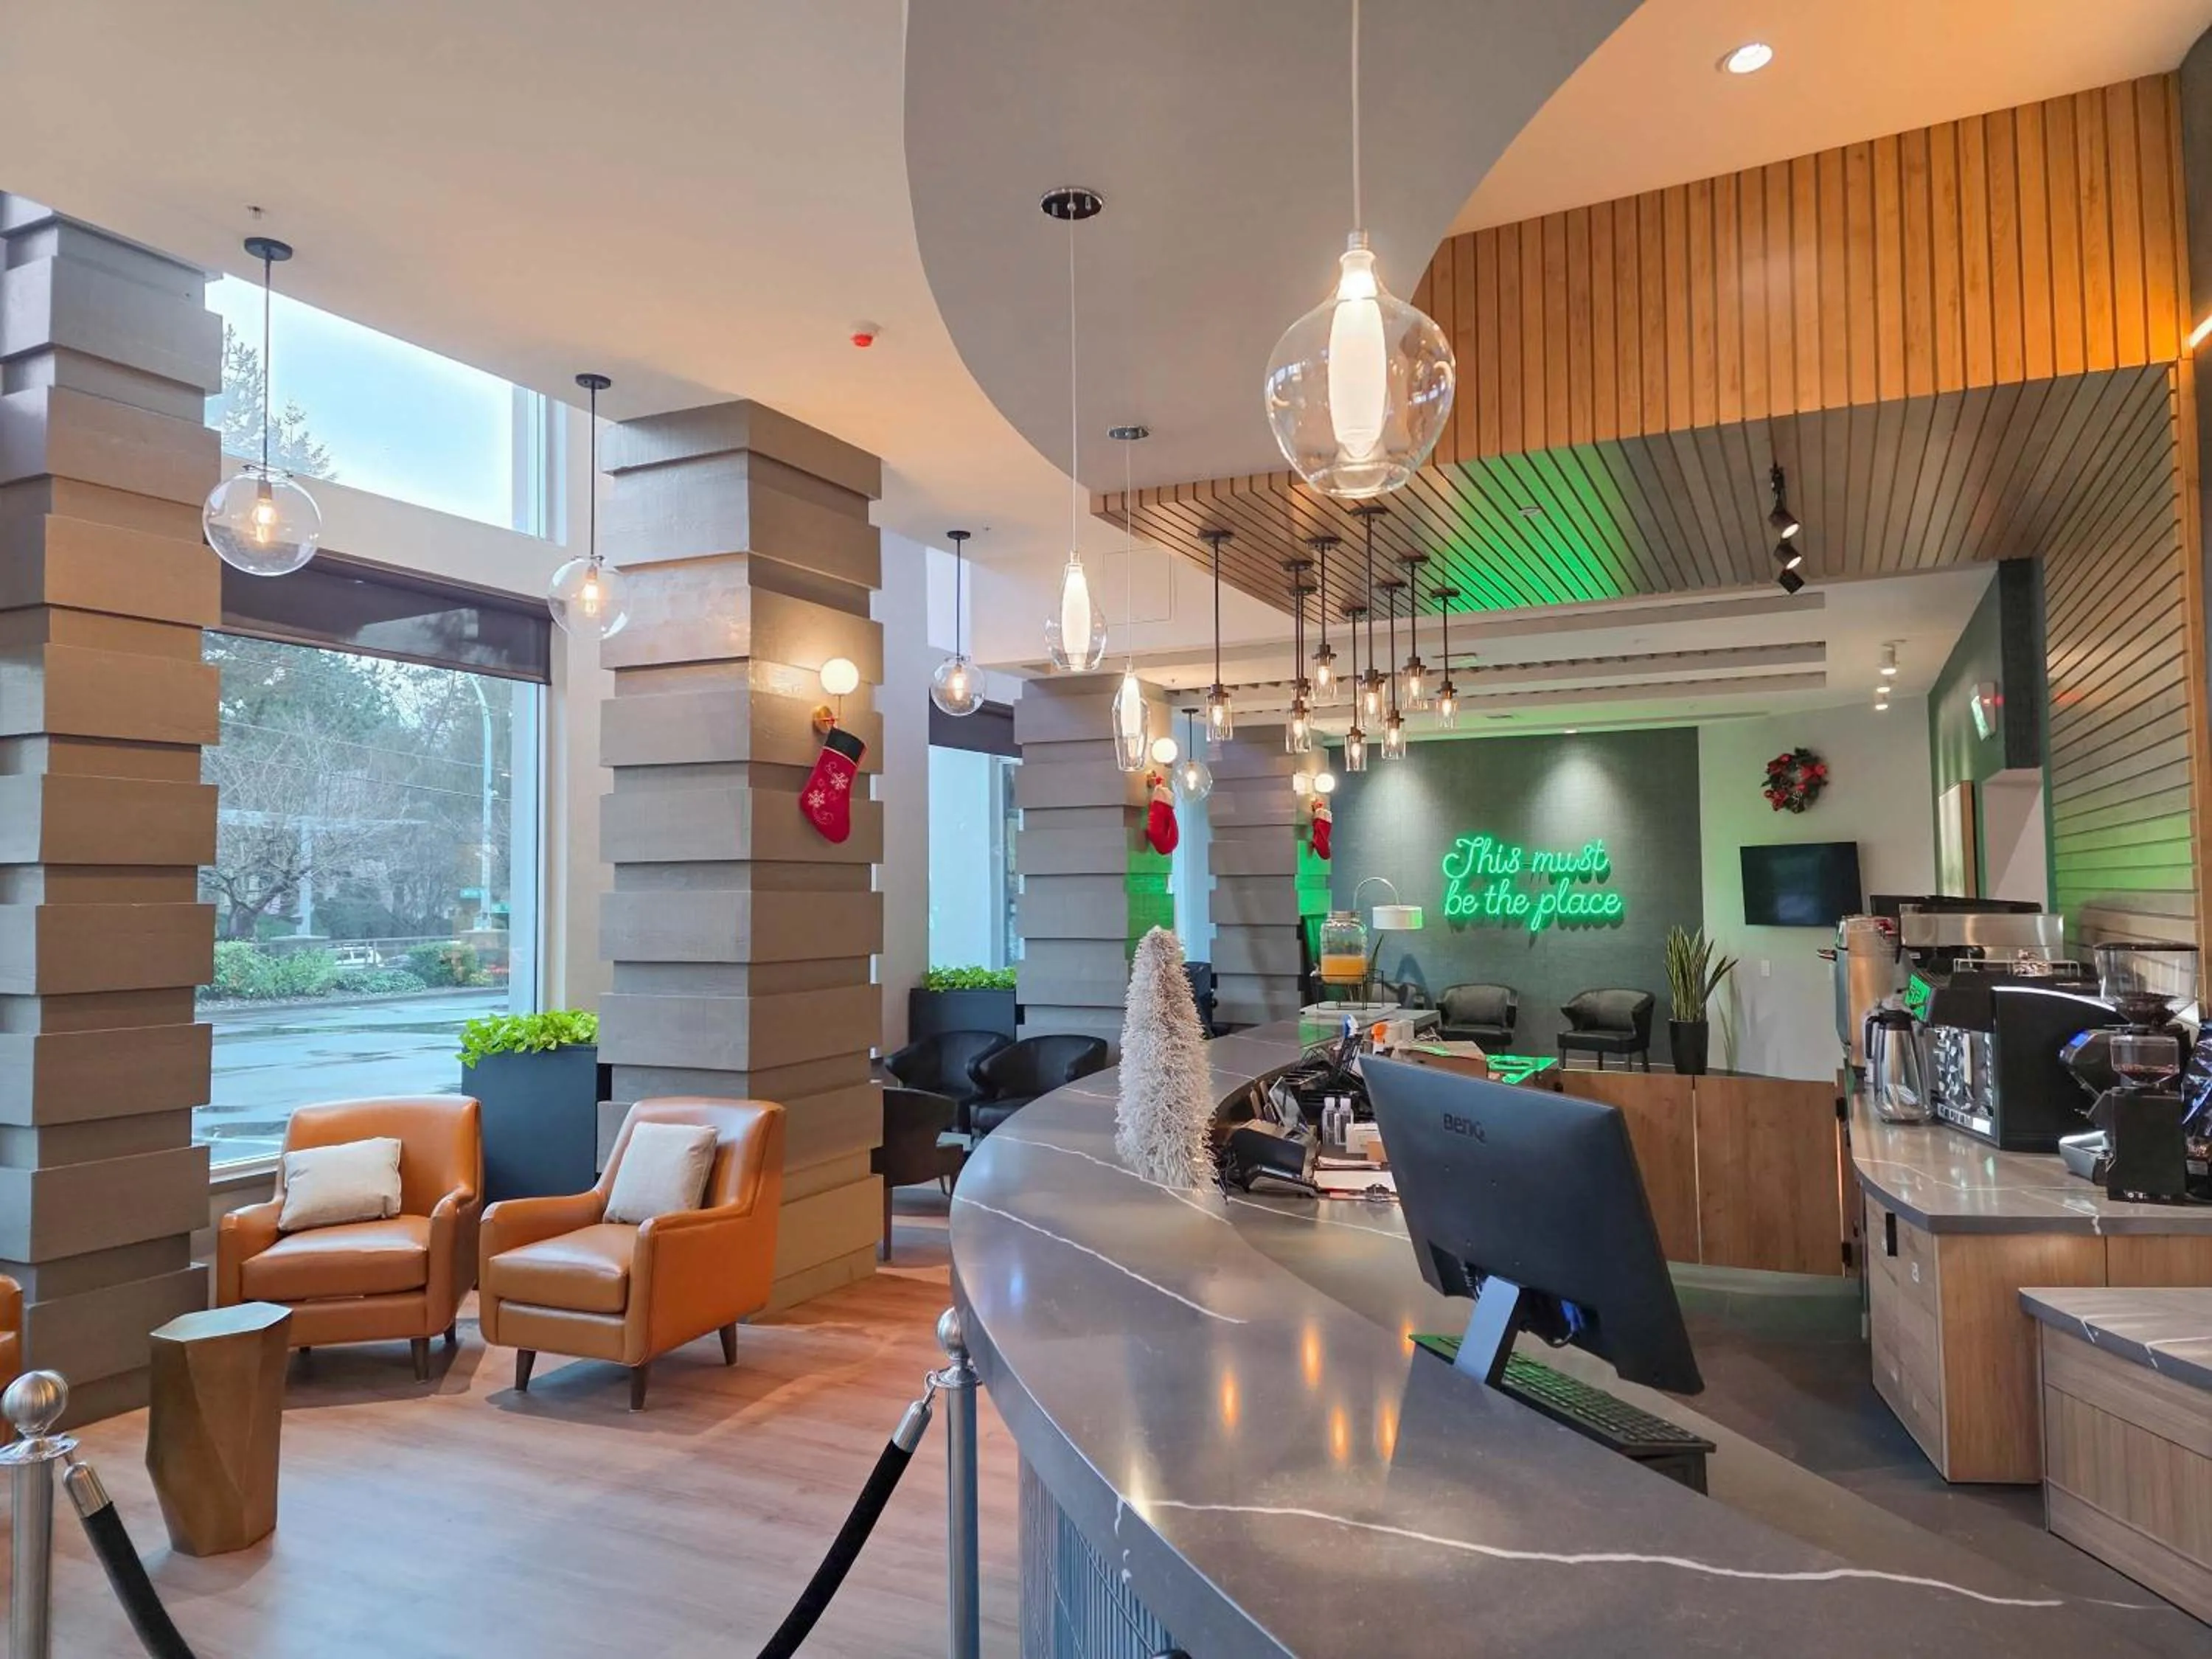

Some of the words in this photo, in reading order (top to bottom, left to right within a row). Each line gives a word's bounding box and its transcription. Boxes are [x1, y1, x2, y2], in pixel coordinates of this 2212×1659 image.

[1442, 837, 1521, 878] This
[1531, 839, 1609, 872] must
[1444, 880, 1477, 915] be
[1484, 878, 1529, 914] the
[1531, 877, 1621, 931] place
